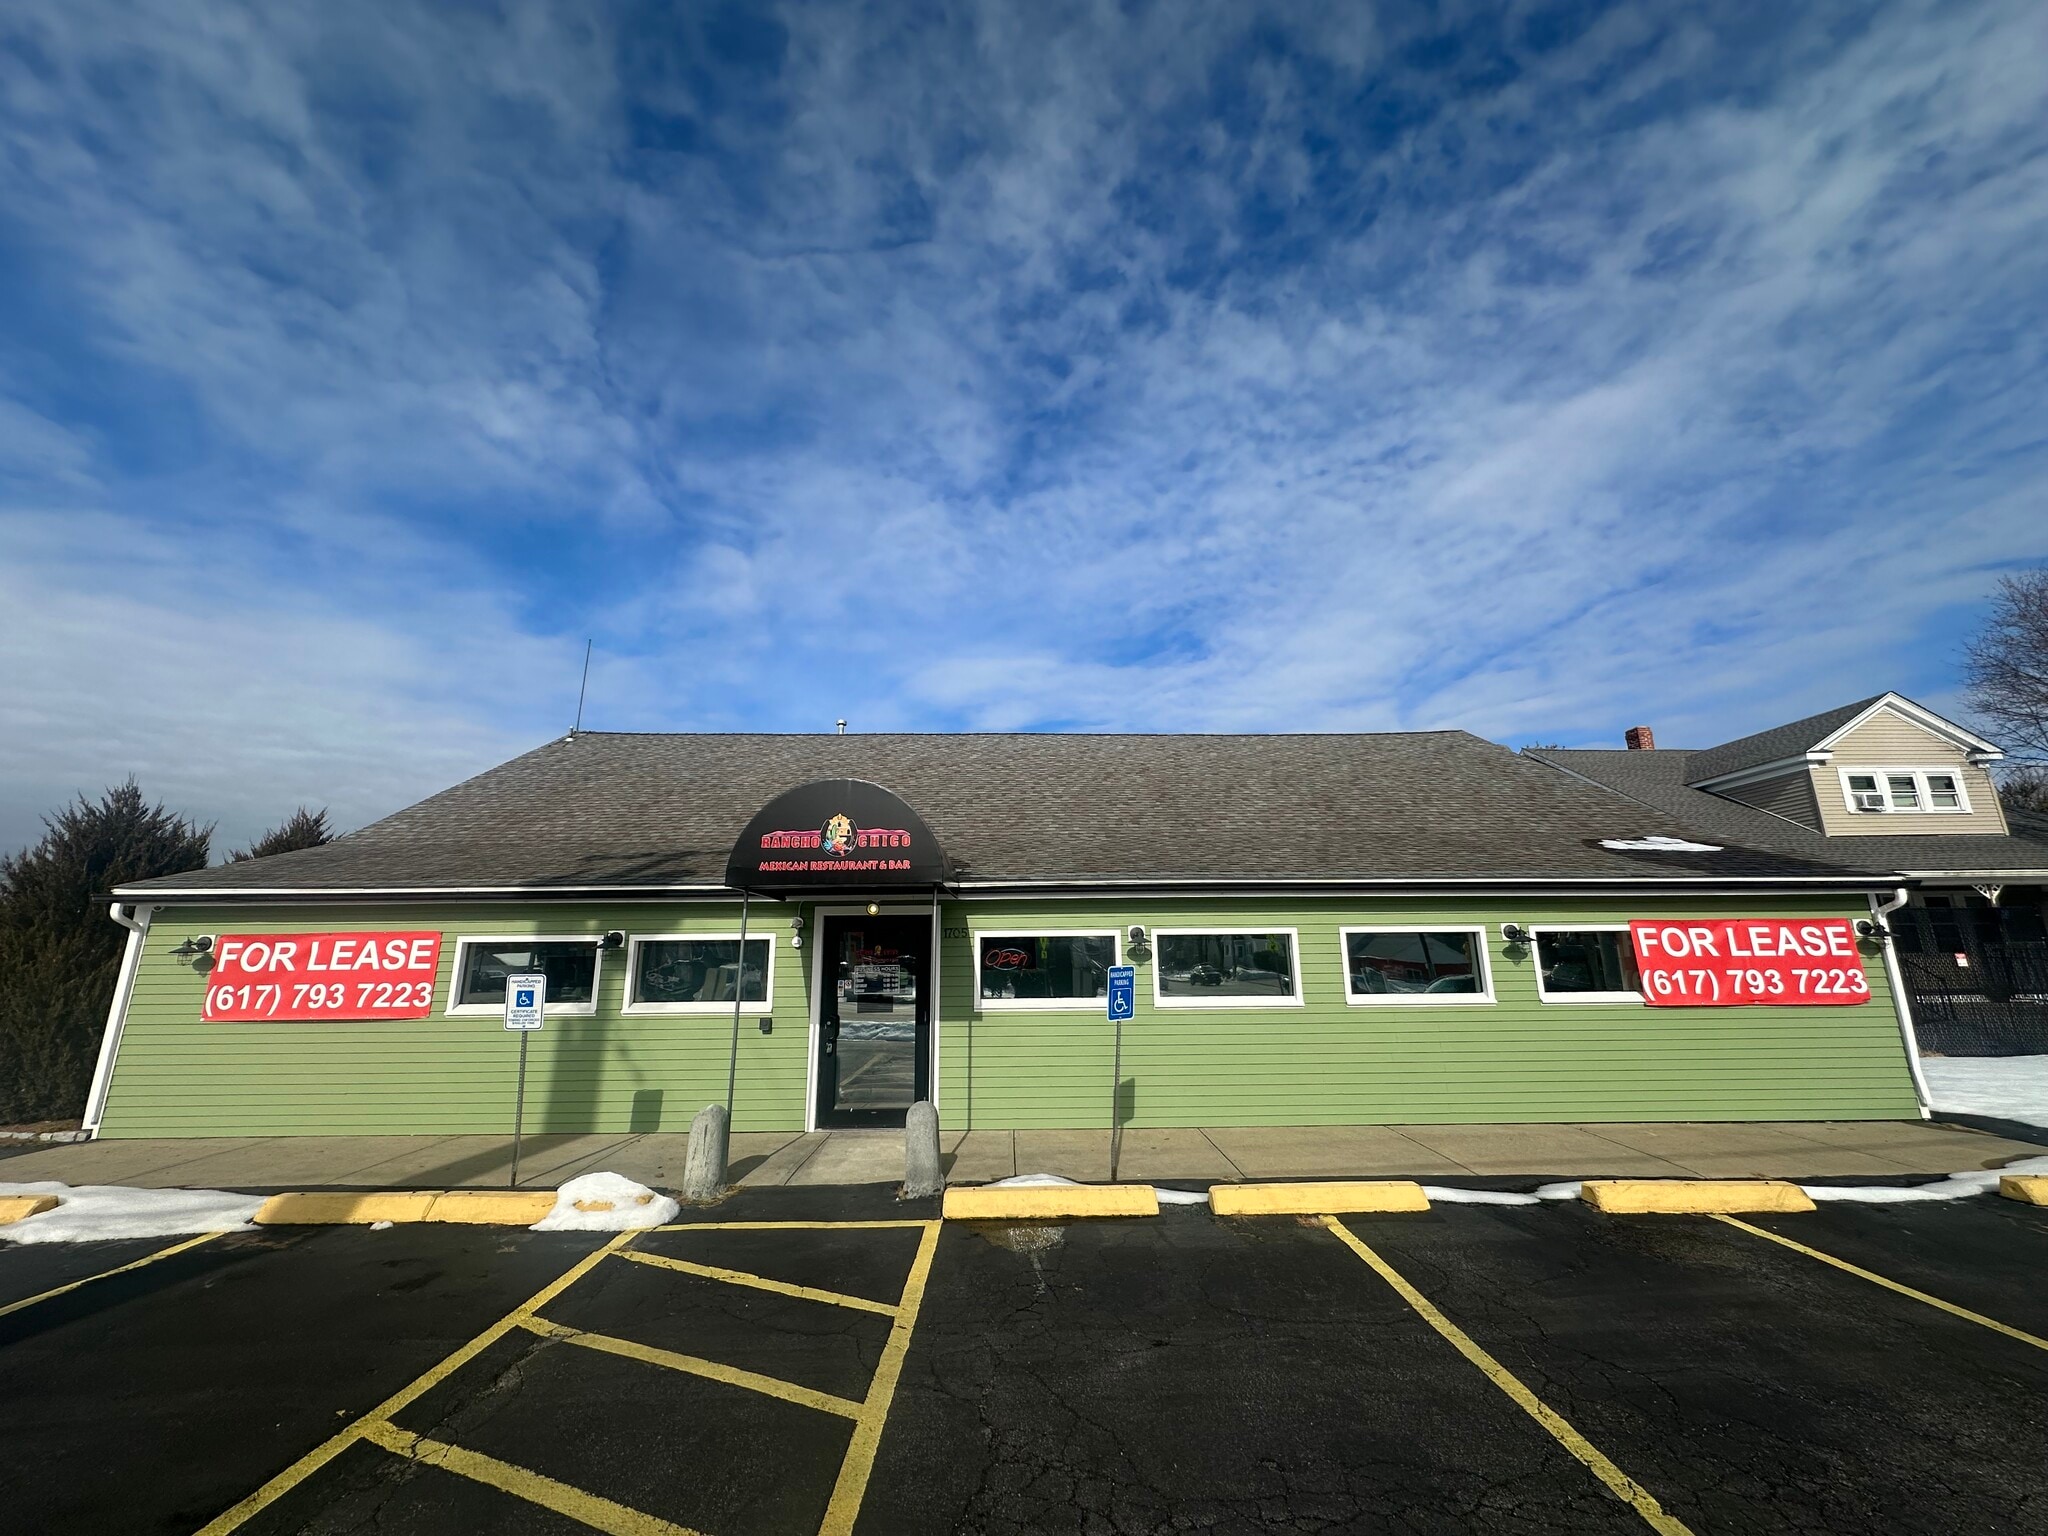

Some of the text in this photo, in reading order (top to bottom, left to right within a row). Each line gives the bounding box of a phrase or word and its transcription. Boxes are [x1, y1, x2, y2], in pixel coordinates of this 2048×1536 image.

[761, 834, 911, 849] RANCHO CHICO
[759, 859, 911, 871] MEXICAN RESTAURANT & BAR
[943, 927, 968, 939] 1705
[1637, 926, 1853, 957] FOR LEASE
[217, 939, 434, 973] FOR LEASE
[985, 949, 1028, 967] Open
[1110, 970, 1133, 978] HANDICAPPED
[1642, 968, 1868, 1001] (617) 793 7223
[205, 982, 432, 1017] (617) 793 7223
